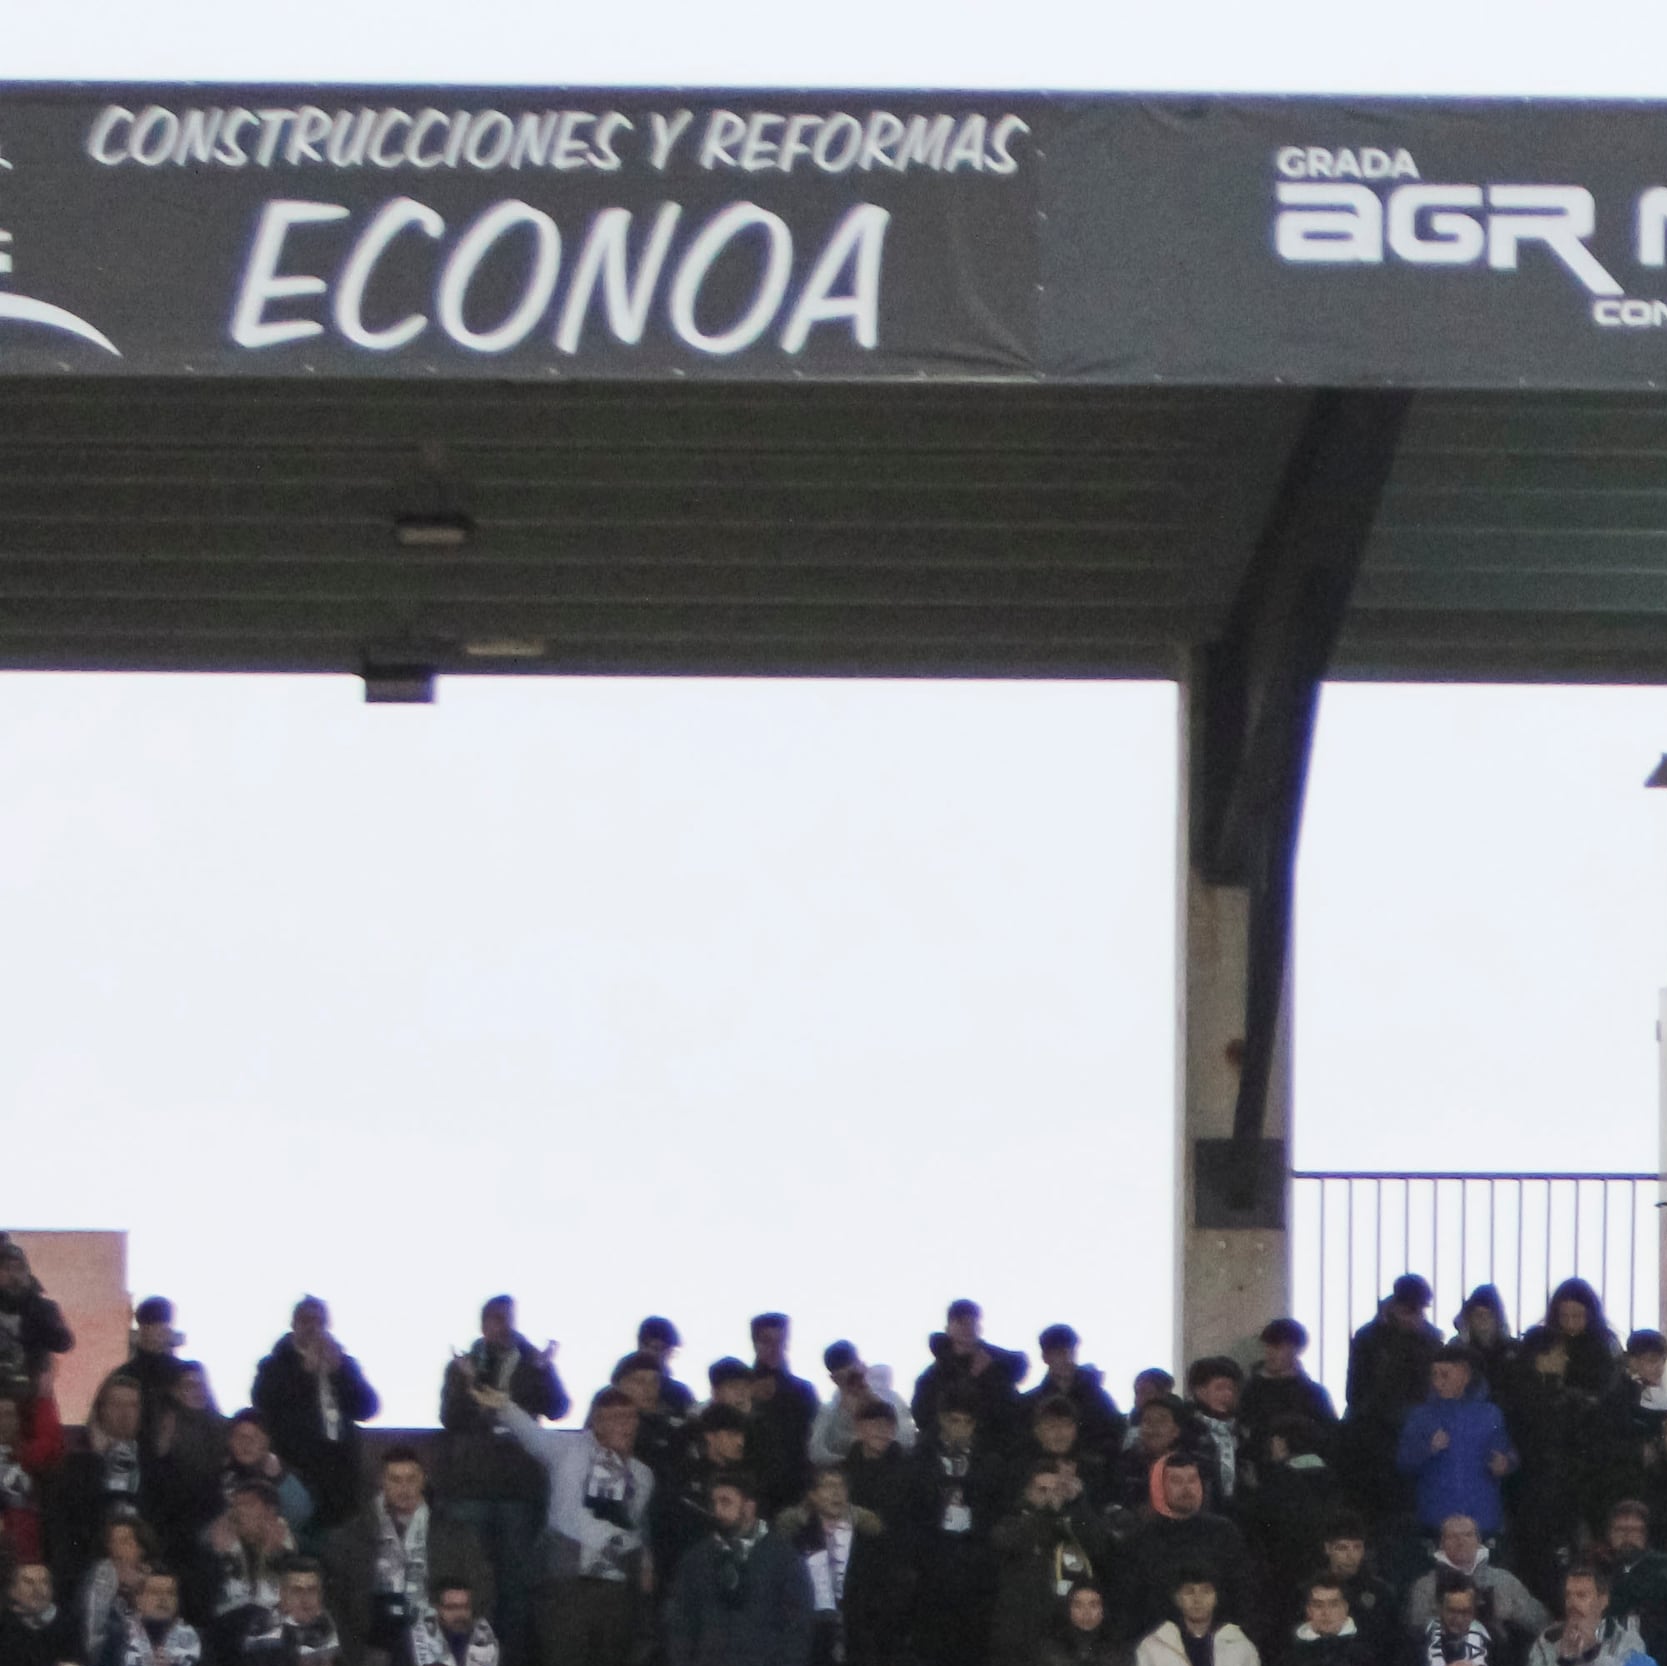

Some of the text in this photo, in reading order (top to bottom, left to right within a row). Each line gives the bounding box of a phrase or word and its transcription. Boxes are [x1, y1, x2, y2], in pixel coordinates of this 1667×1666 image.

[86, 105, 1031, 177] CONSTRUCCIONES Y REFORMAS
[1277, 147, 1420, 180] GRADA
[230, 198, 891, 357] ECONOA
